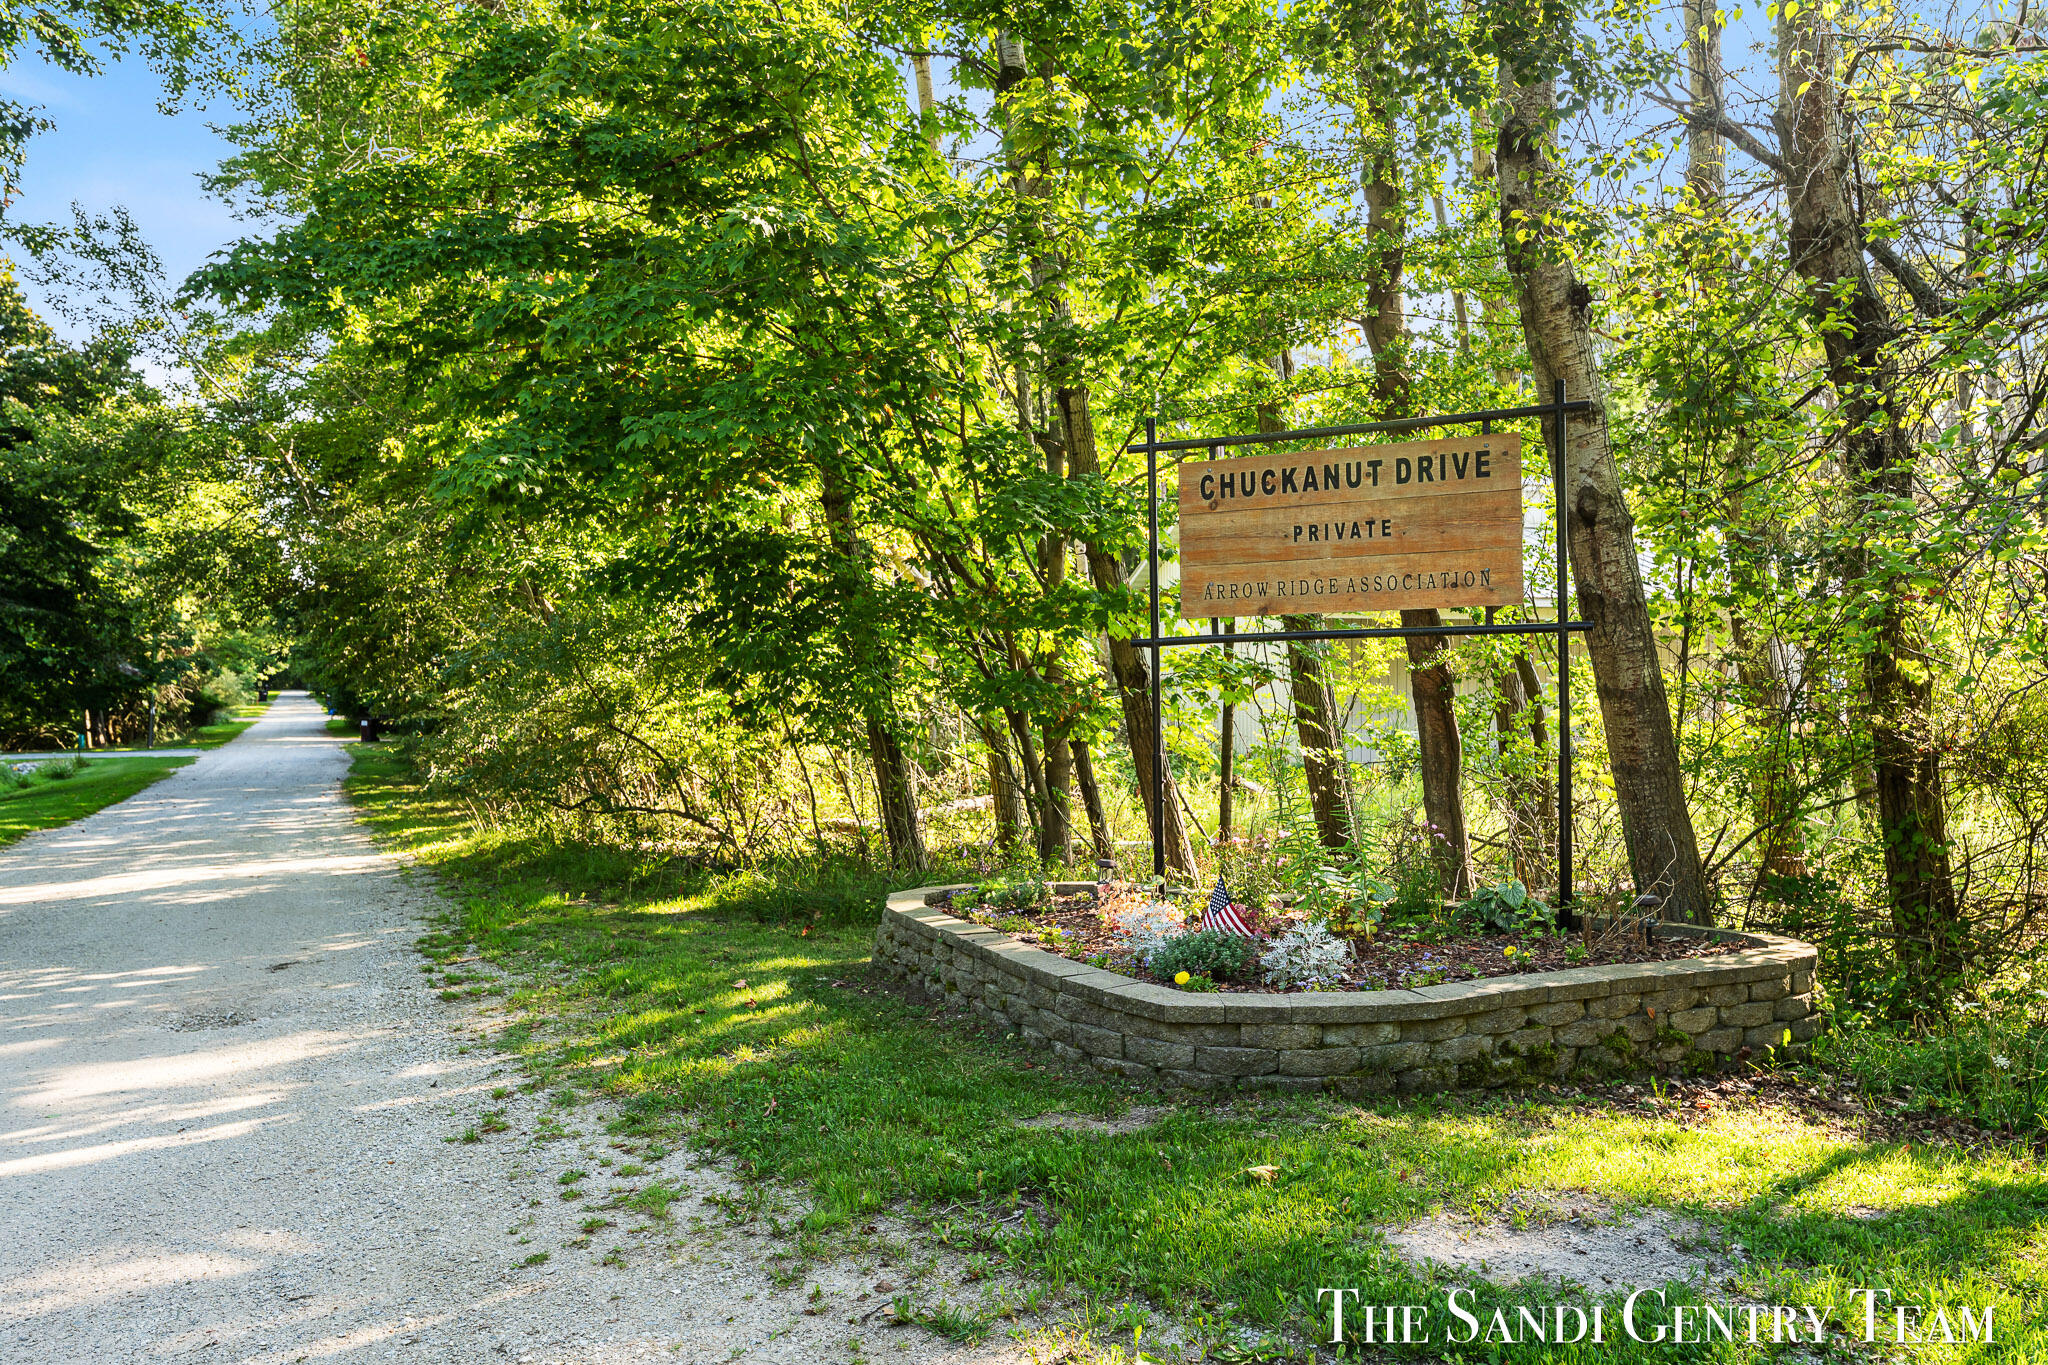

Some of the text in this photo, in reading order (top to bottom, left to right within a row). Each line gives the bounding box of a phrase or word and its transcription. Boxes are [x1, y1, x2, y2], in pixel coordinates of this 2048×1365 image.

[1200, 450, 1491, 500] CHUCKANUT DRIVE
[1293, 519, 1392, 542] PRIVATE
[1204, 569, 1491, 600] ARROW RIDGE ASSOCIATION
